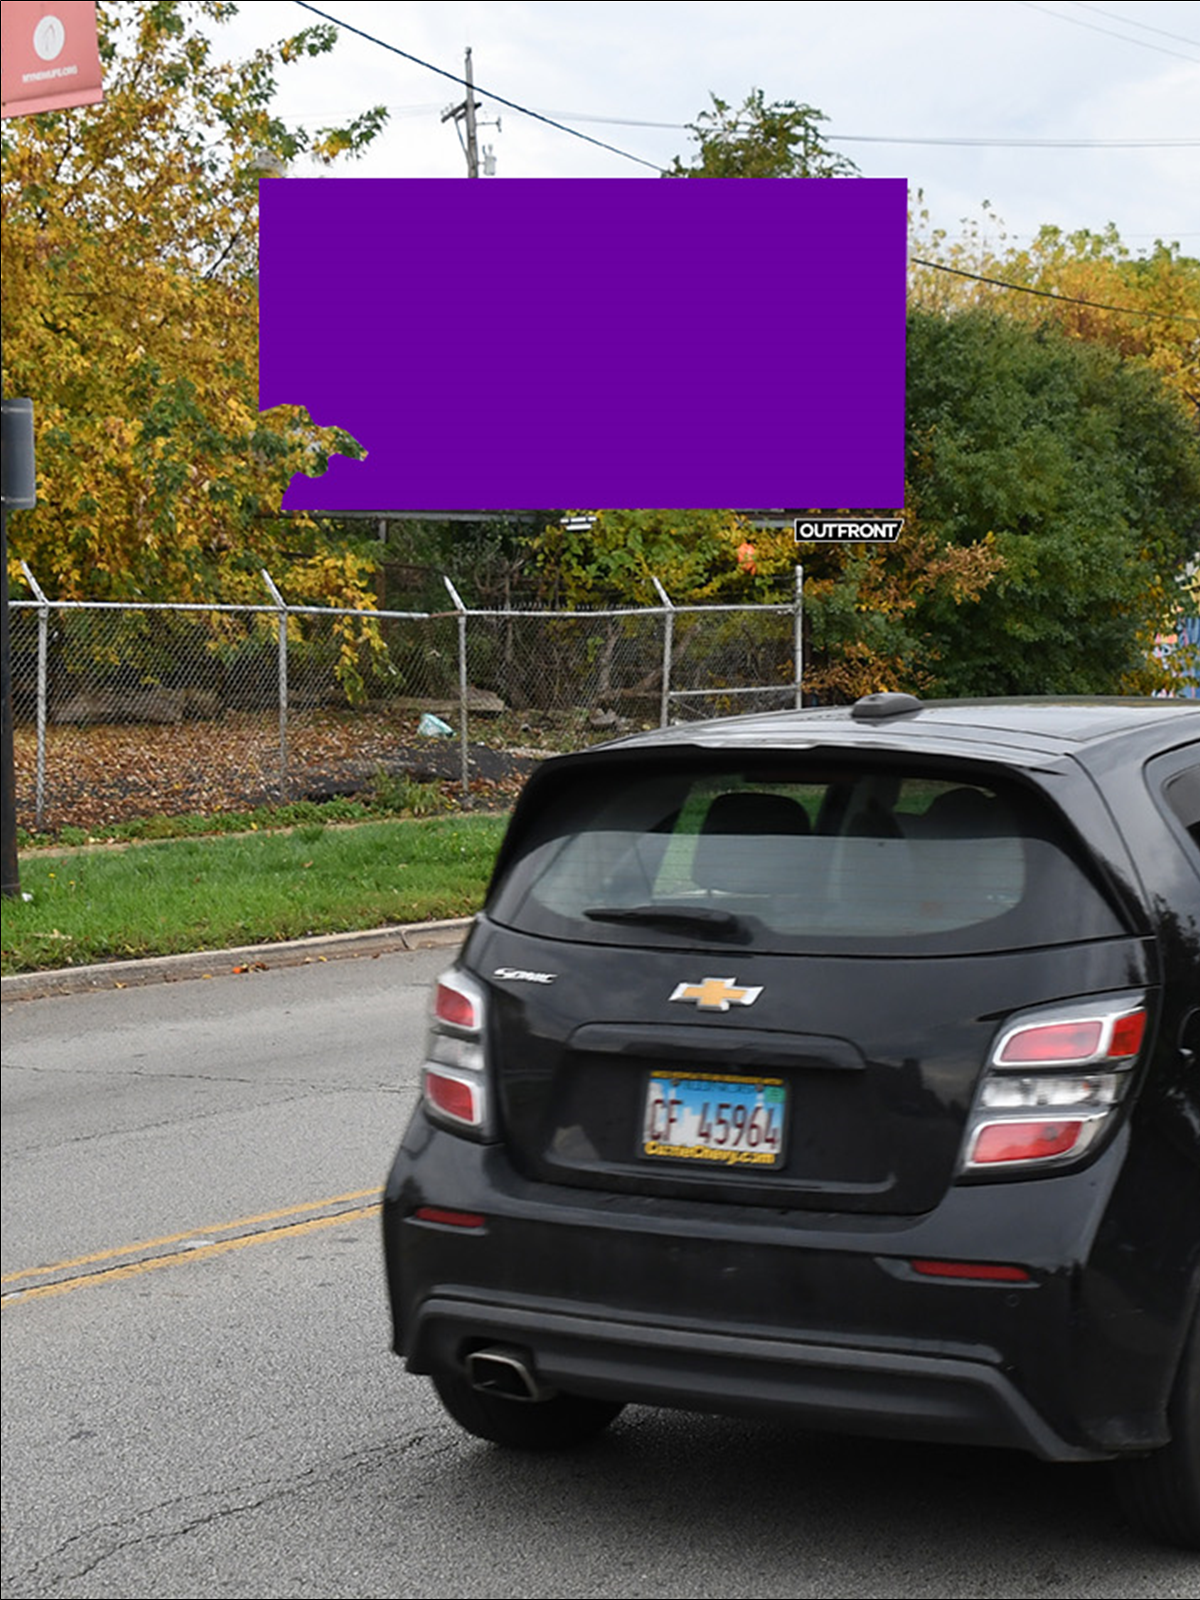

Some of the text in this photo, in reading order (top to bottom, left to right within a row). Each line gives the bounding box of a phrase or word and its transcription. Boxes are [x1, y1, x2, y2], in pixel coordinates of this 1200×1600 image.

[799, 523, 898, 538] OUTFRONT
[650, 1098, 779, 1150] CF 45964
